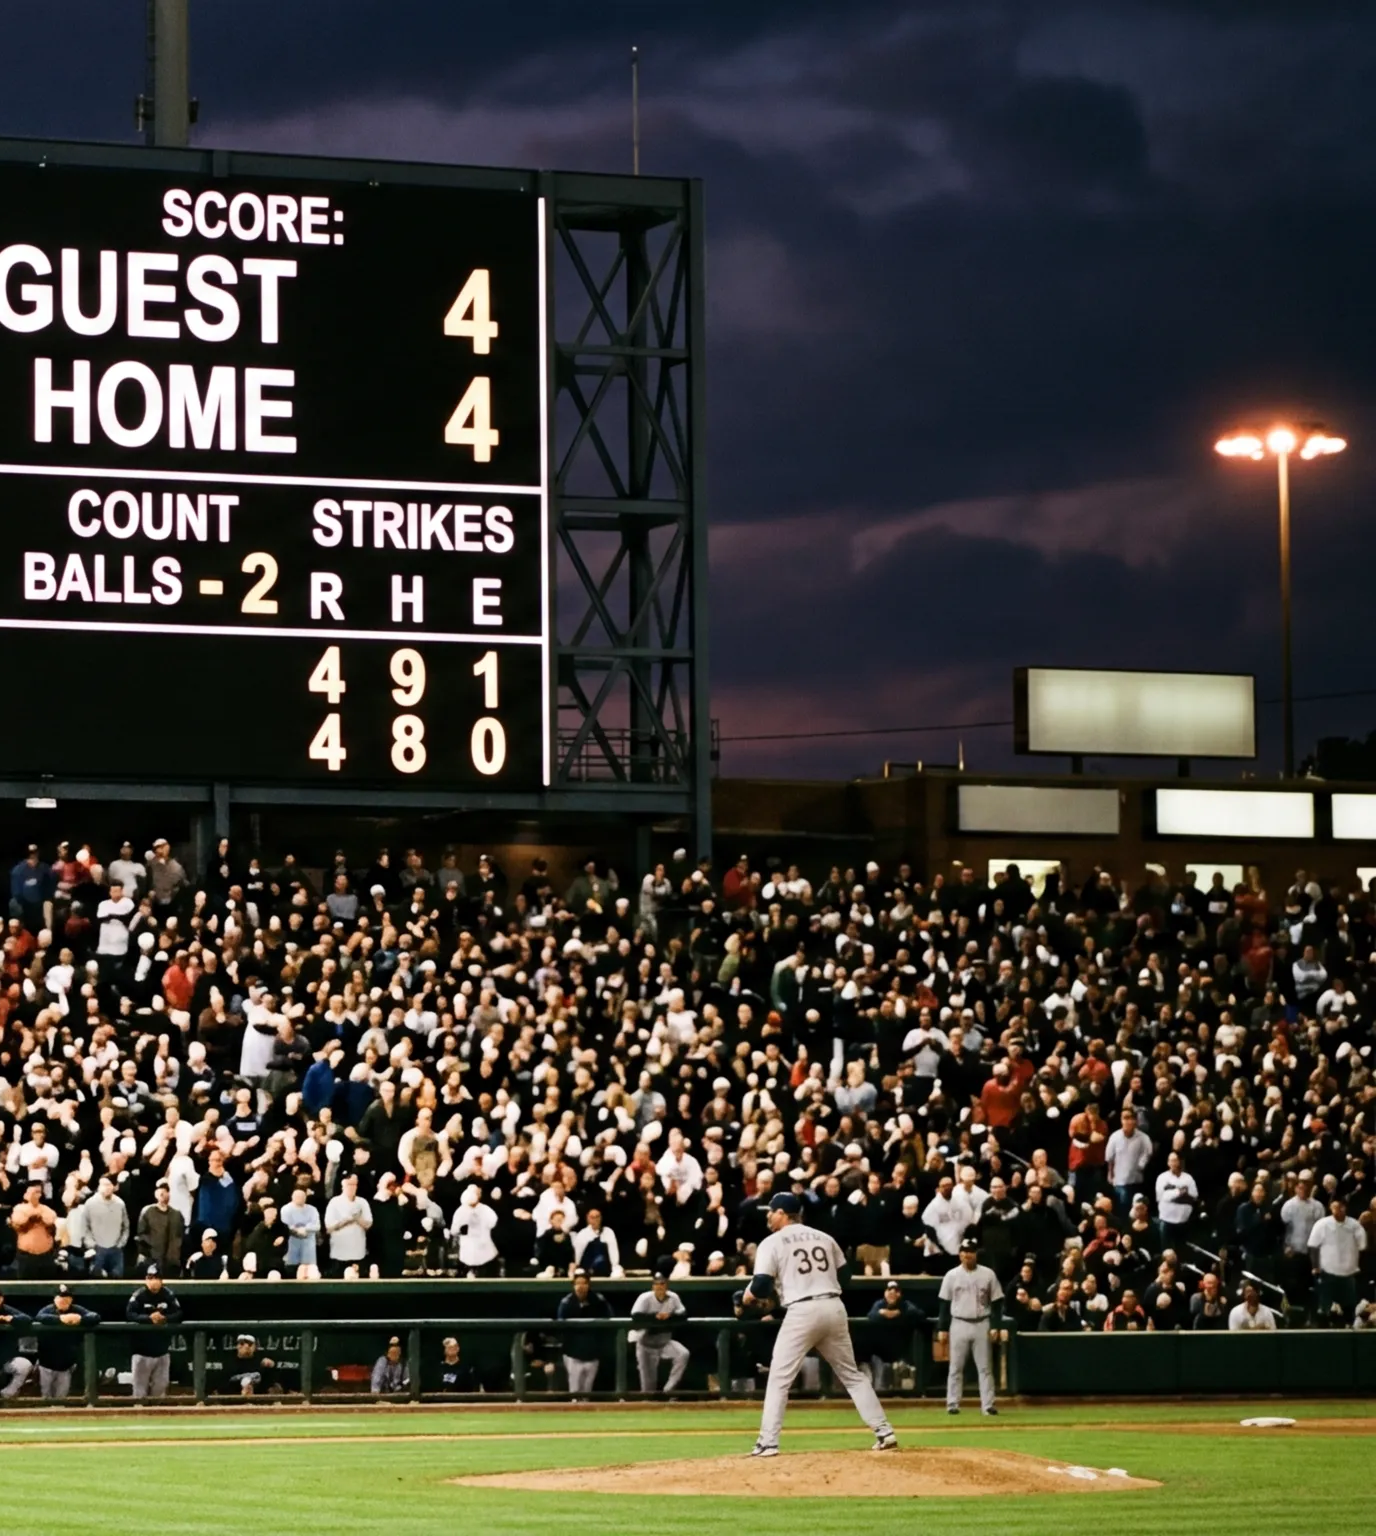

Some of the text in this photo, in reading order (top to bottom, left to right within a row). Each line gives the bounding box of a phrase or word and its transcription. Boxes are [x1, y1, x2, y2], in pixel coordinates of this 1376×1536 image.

[161, 188, 344, 246] SCORE:
[443, 268, 499, 355] 4
[34, 357, 500, 463] HOME 4
[67, 488, 240, 543] COUNT
[312, 498, 515, 554] STRIKES
[24, 551, 183, 606] BALLS
[240, 551, 279, 615] 2
[310, 571, 503, 626] R H E
[308, 645, 346, 704] 4
[389, 647, 426, 707] 9
[473, 650, 499, 709] 1
[308, 712, 347, 771] 4
[390, 713, 427, 774] 8
[470, 716, 507, 776] 0
[792, 1245, 830, 1275] 39
